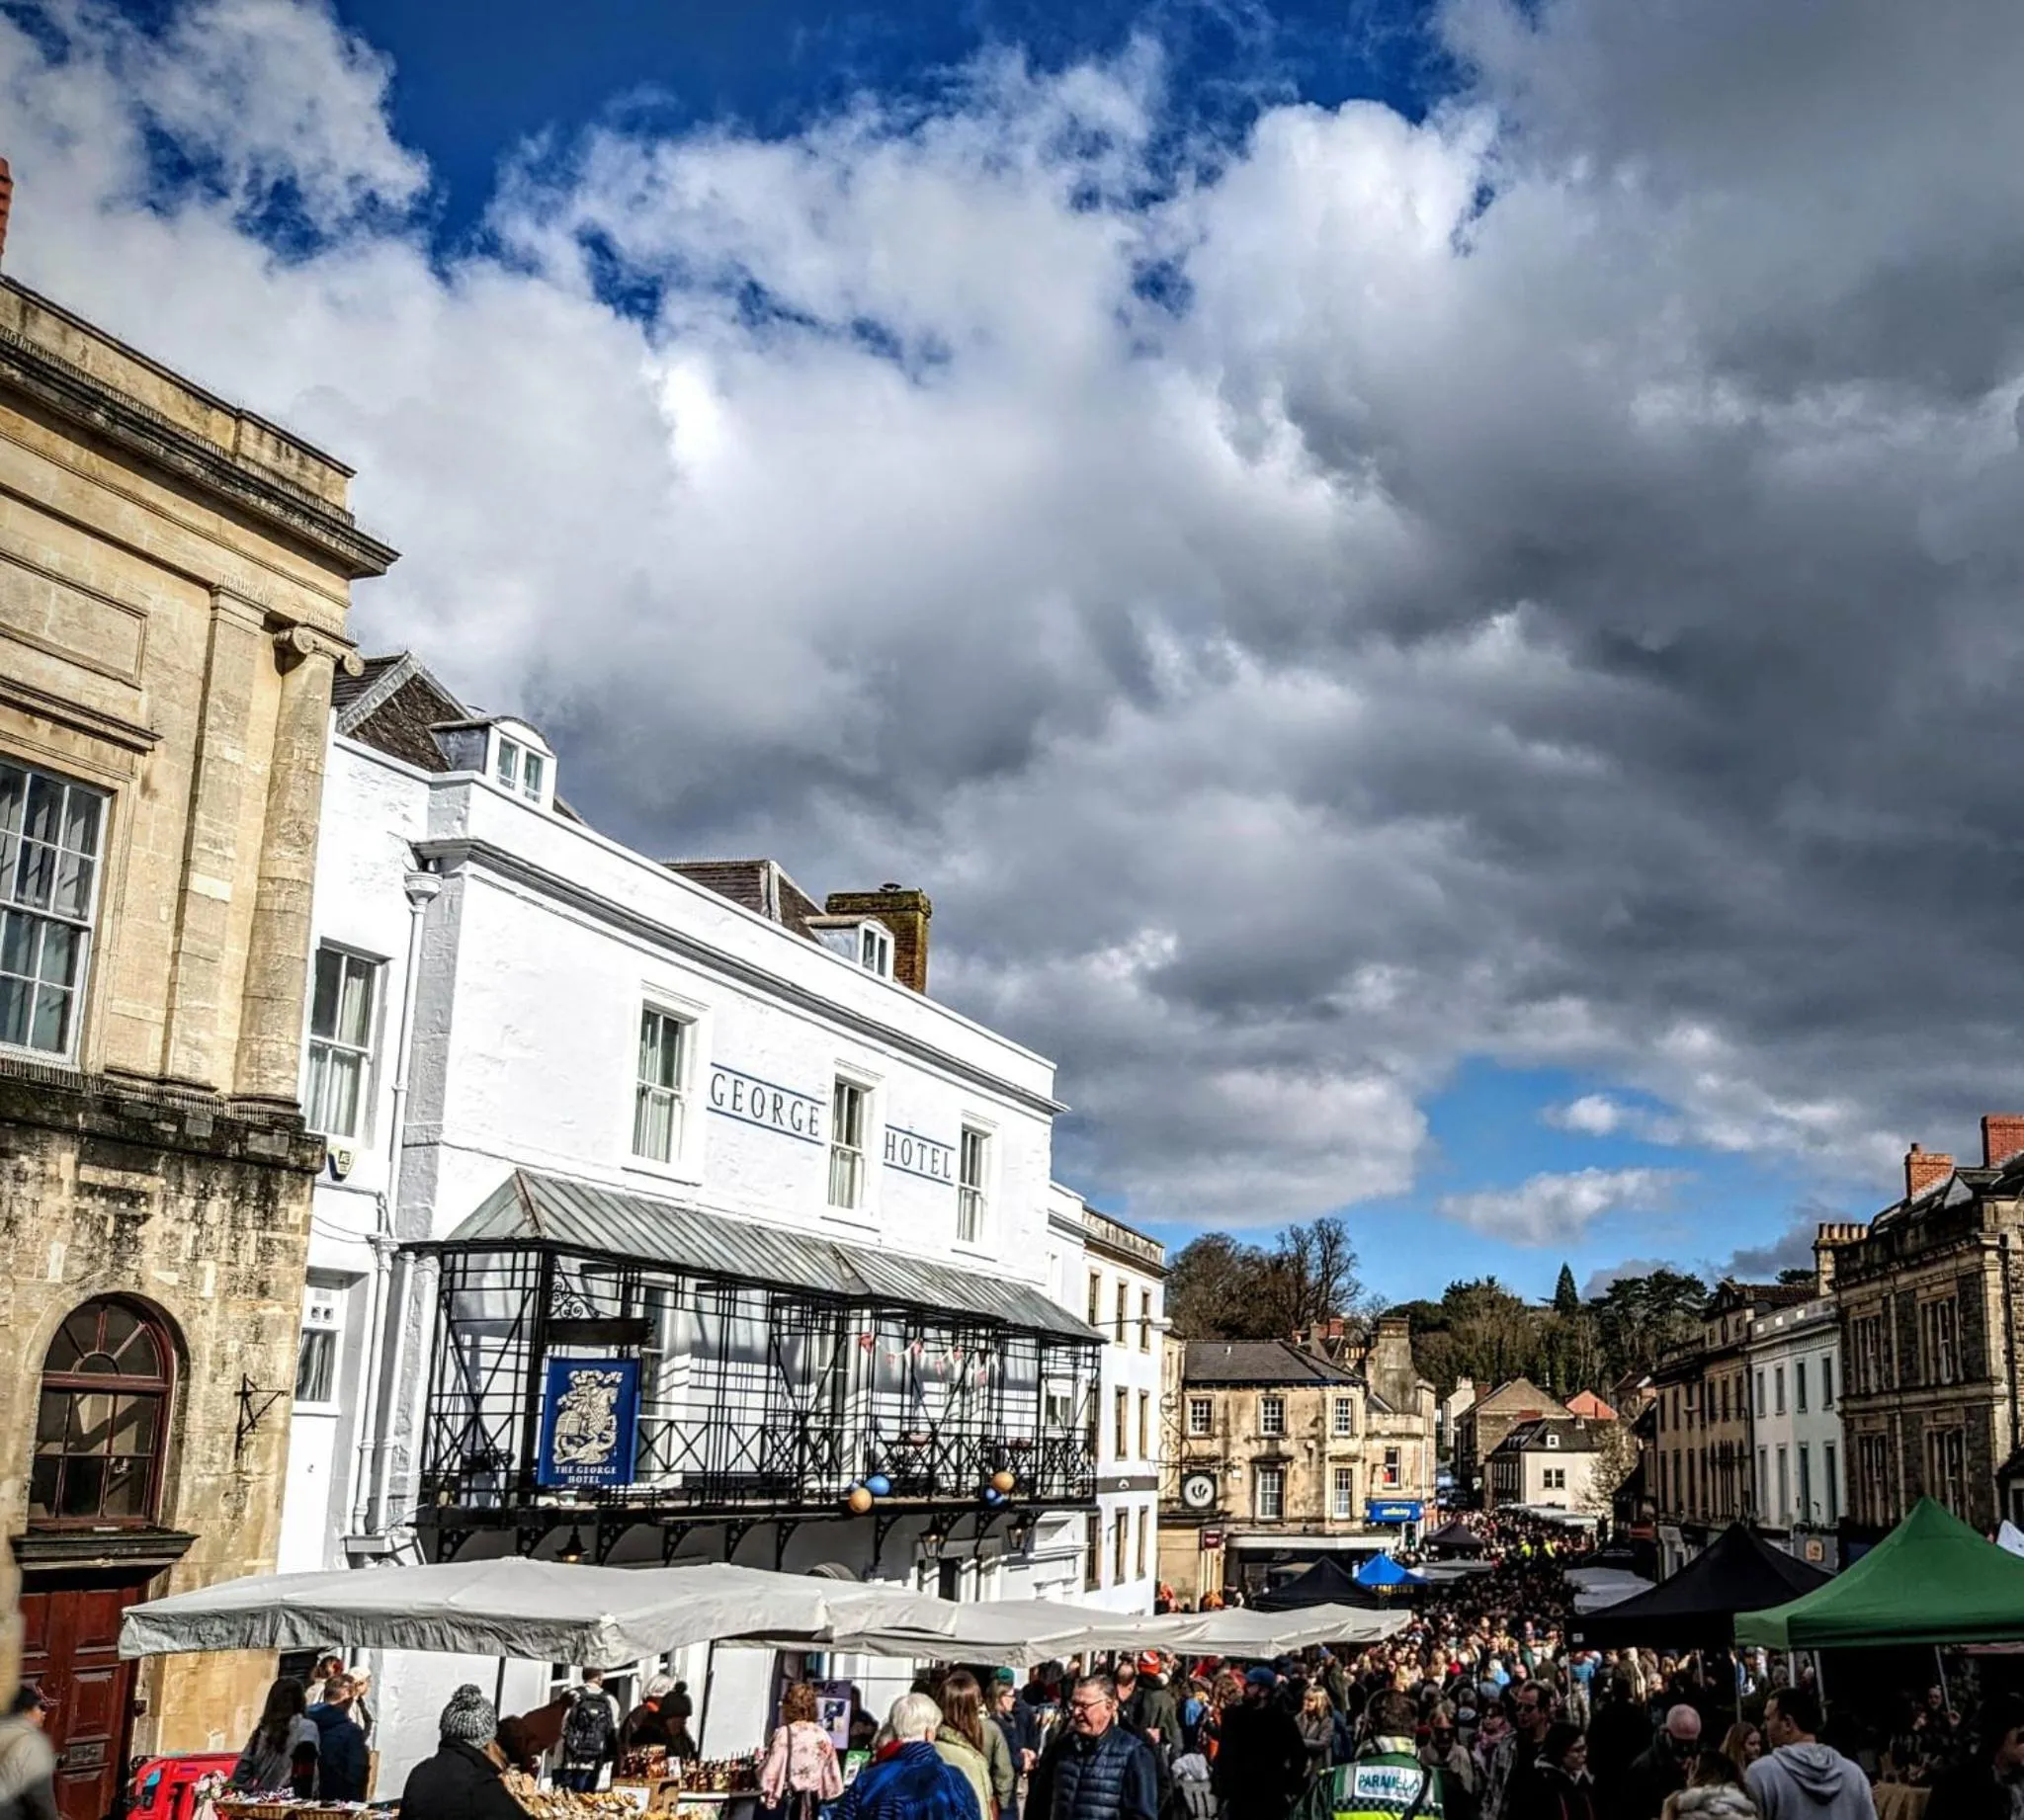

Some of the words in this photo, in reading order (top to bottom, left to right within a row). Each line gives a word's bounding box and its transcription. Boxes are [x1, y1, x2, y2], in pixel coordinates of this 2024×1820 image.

[711, 1073, 819, 1137] GEORGE
[884, 1130, 952, 1179] HOTEL
[554, 1465, 574, 1474] THE
[575, 1465, 618, 1474] GEORGE
[567, 1475, 601, 1484] HOTEL
